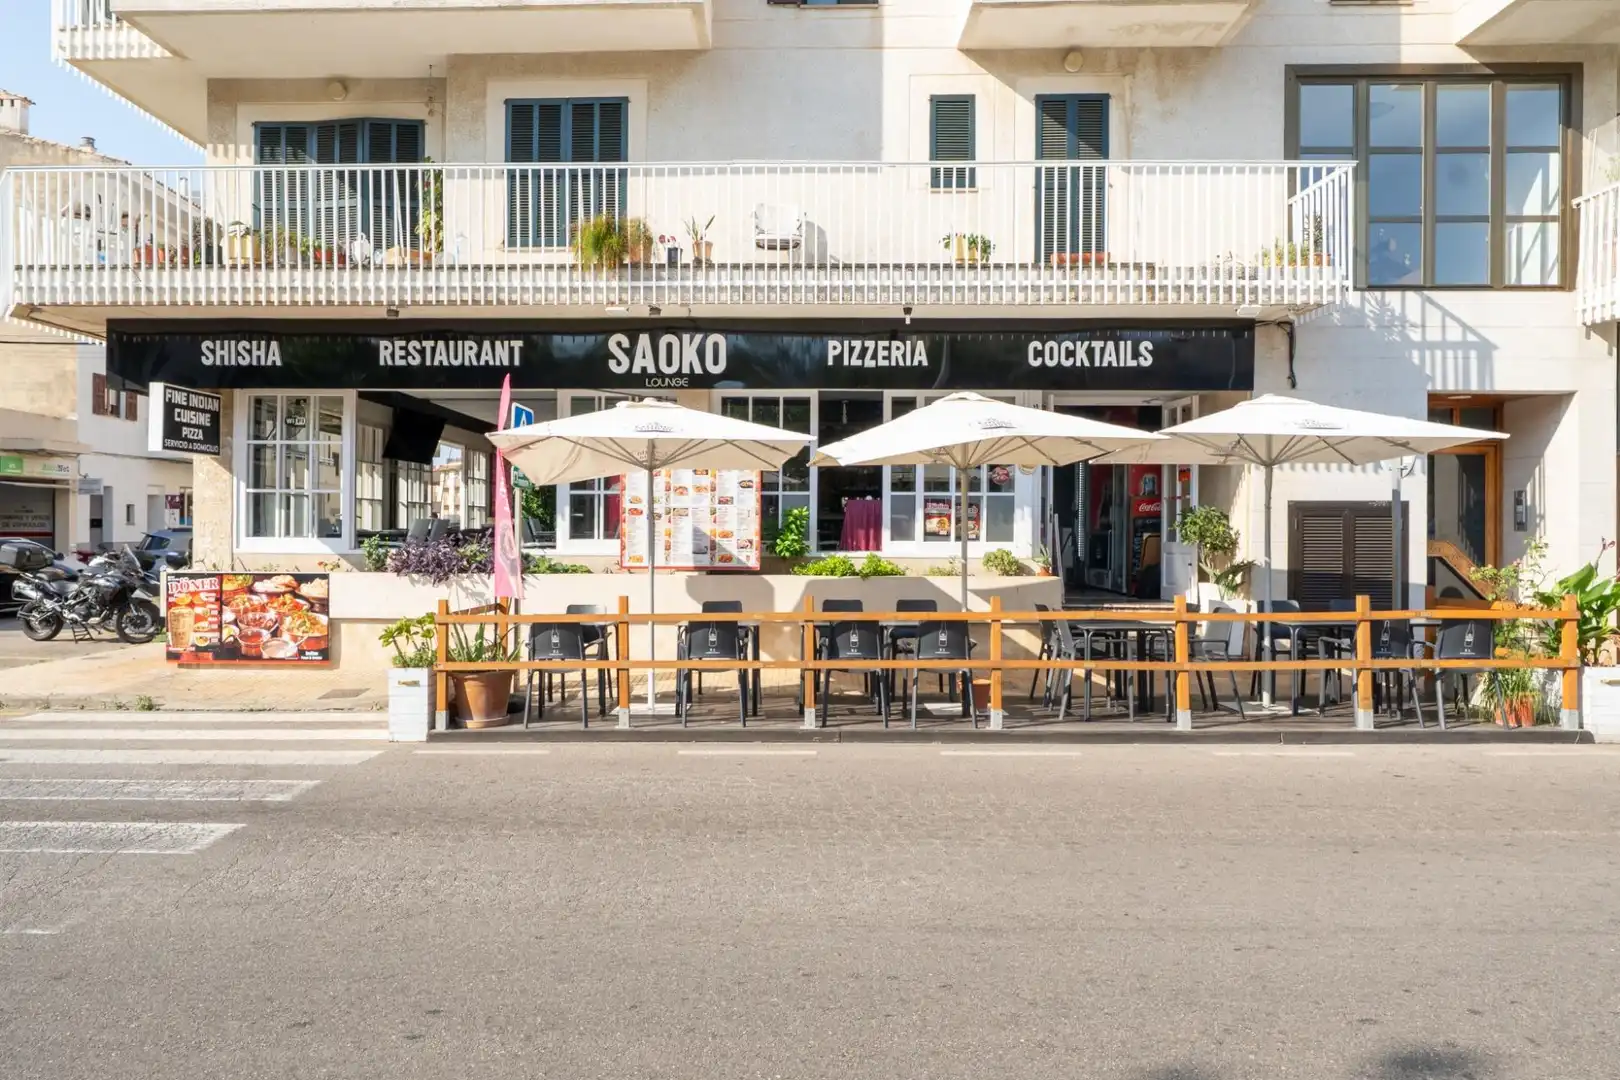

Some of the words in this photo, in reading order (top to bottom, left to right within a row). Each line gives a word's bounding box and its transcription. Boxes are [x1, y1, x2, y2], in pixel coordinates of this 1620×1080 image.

[201, 340, 282, 367] SHISHA
[379, 340, 523, 367] RESTAURANT
[607, 333, 728, 375] SAOKO
[827, 339, 929, 368] PIZZERIA
[1028, 340, 1154, 367] COCKTAILS
[645, 377, 689, 388] LOUNGE
[165, 388, 188, 405] FINE
[189, 393, 219, 412] INDIAN
[174, 407, 211, 427] CUISINE
[164, 438, 188, 449] SERVICIO
[193, 443, 219, 453] DOMICILIO
[182, 427, 203, 440] PIZZA
[168, 577, 219, 594] DÖNER
